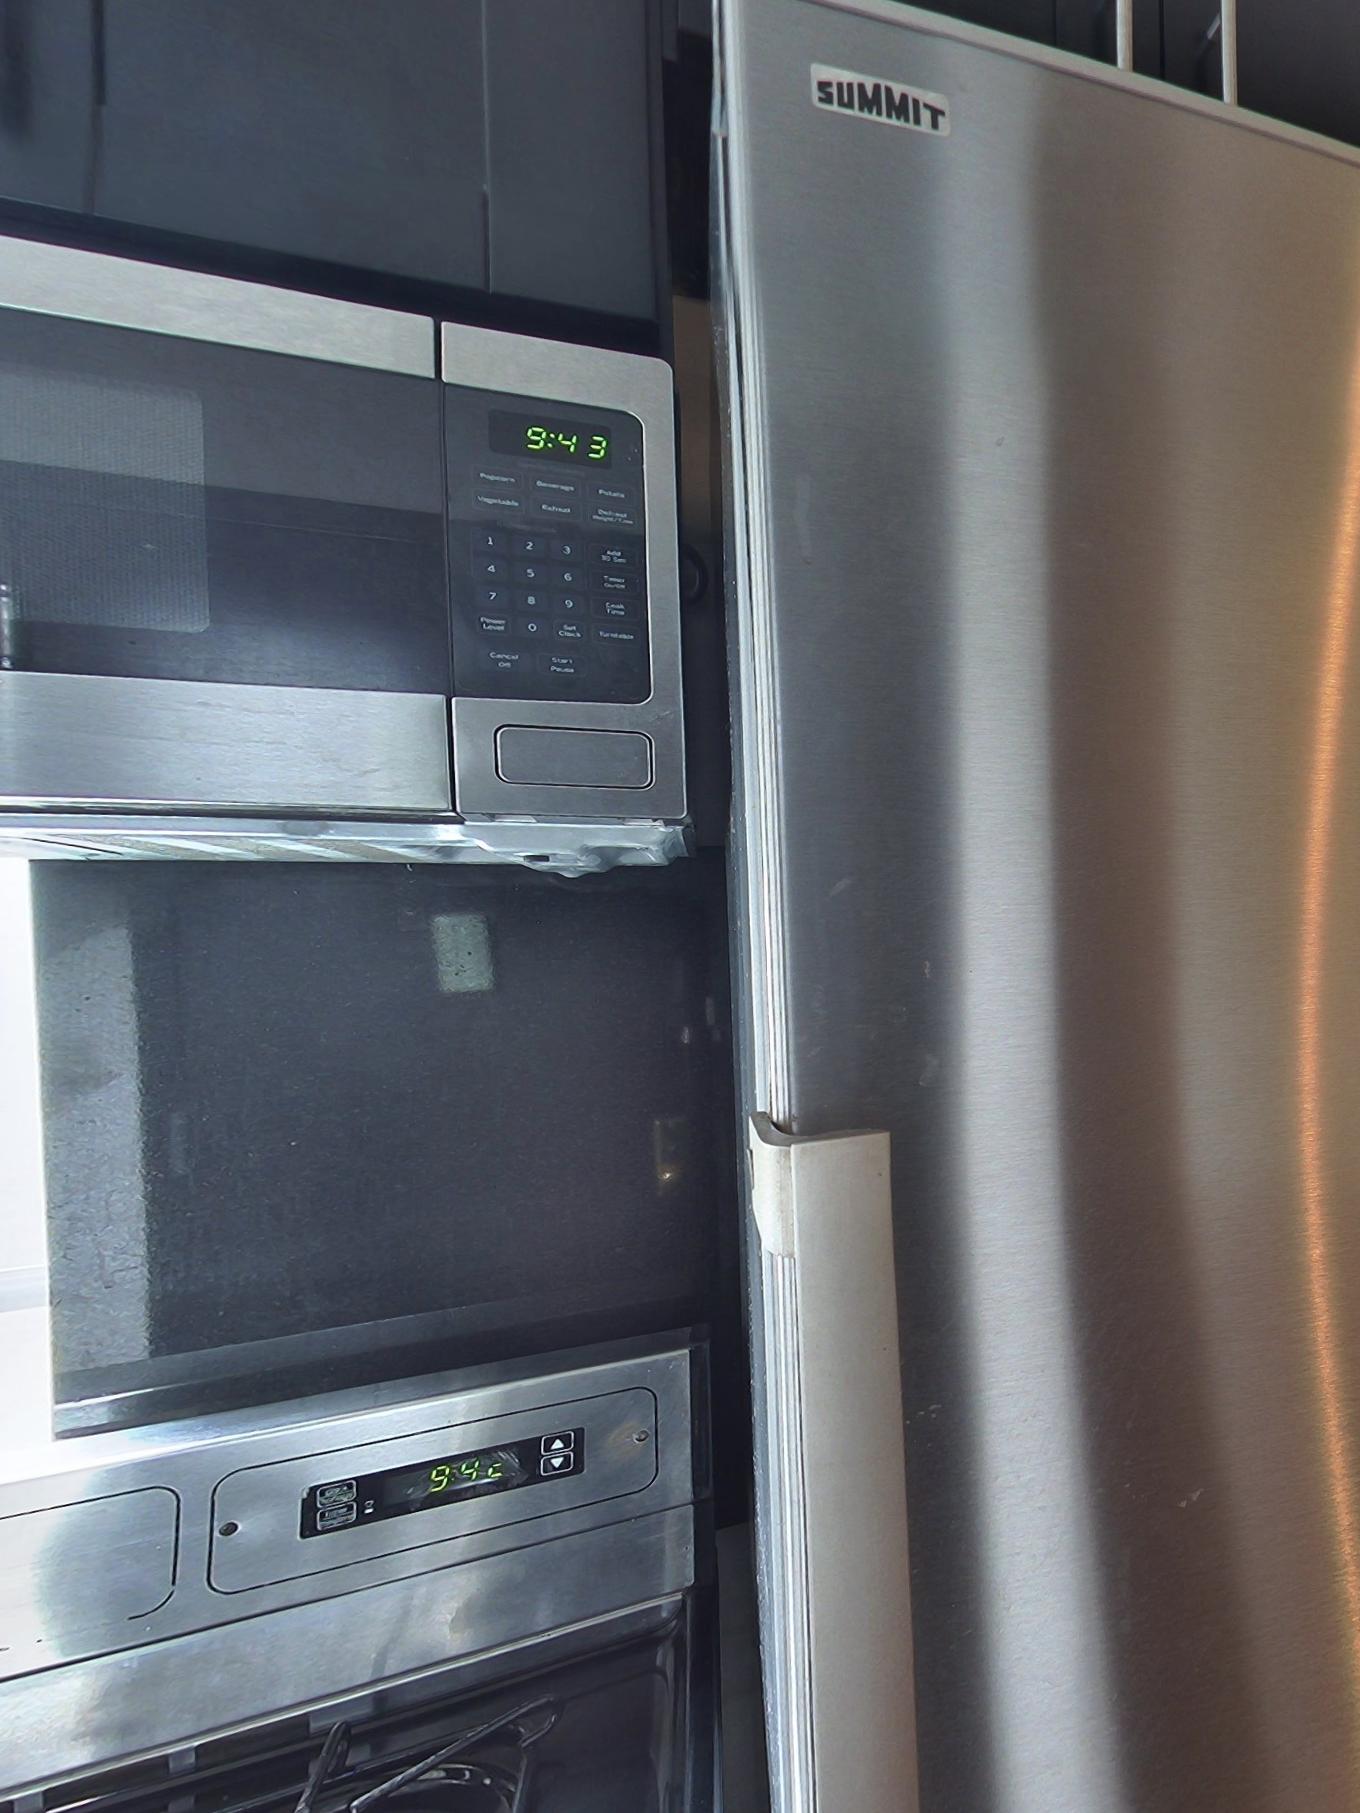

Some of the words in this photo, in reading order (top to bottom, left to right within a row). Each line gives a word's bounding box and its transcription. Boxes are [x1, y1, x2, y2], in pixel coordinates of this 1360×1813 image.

[816, 80, 946, 131] SUMMIT
[526, 426, 608, 460] 9:43
[486, 535, 494, 546] 1
[525, 541, 534, 551] 2
[562, 545, 571, 556] 3
[487, 564, 497, 574] 4
[526, 568, 535, 579] 5
[563, 572, 573, 583] 6
[488, 591, 497, 601] 7
[527, 595, 536, 606] 8
[564, 599, 574, 609] 9
[527, 623, 537, 633] 0
